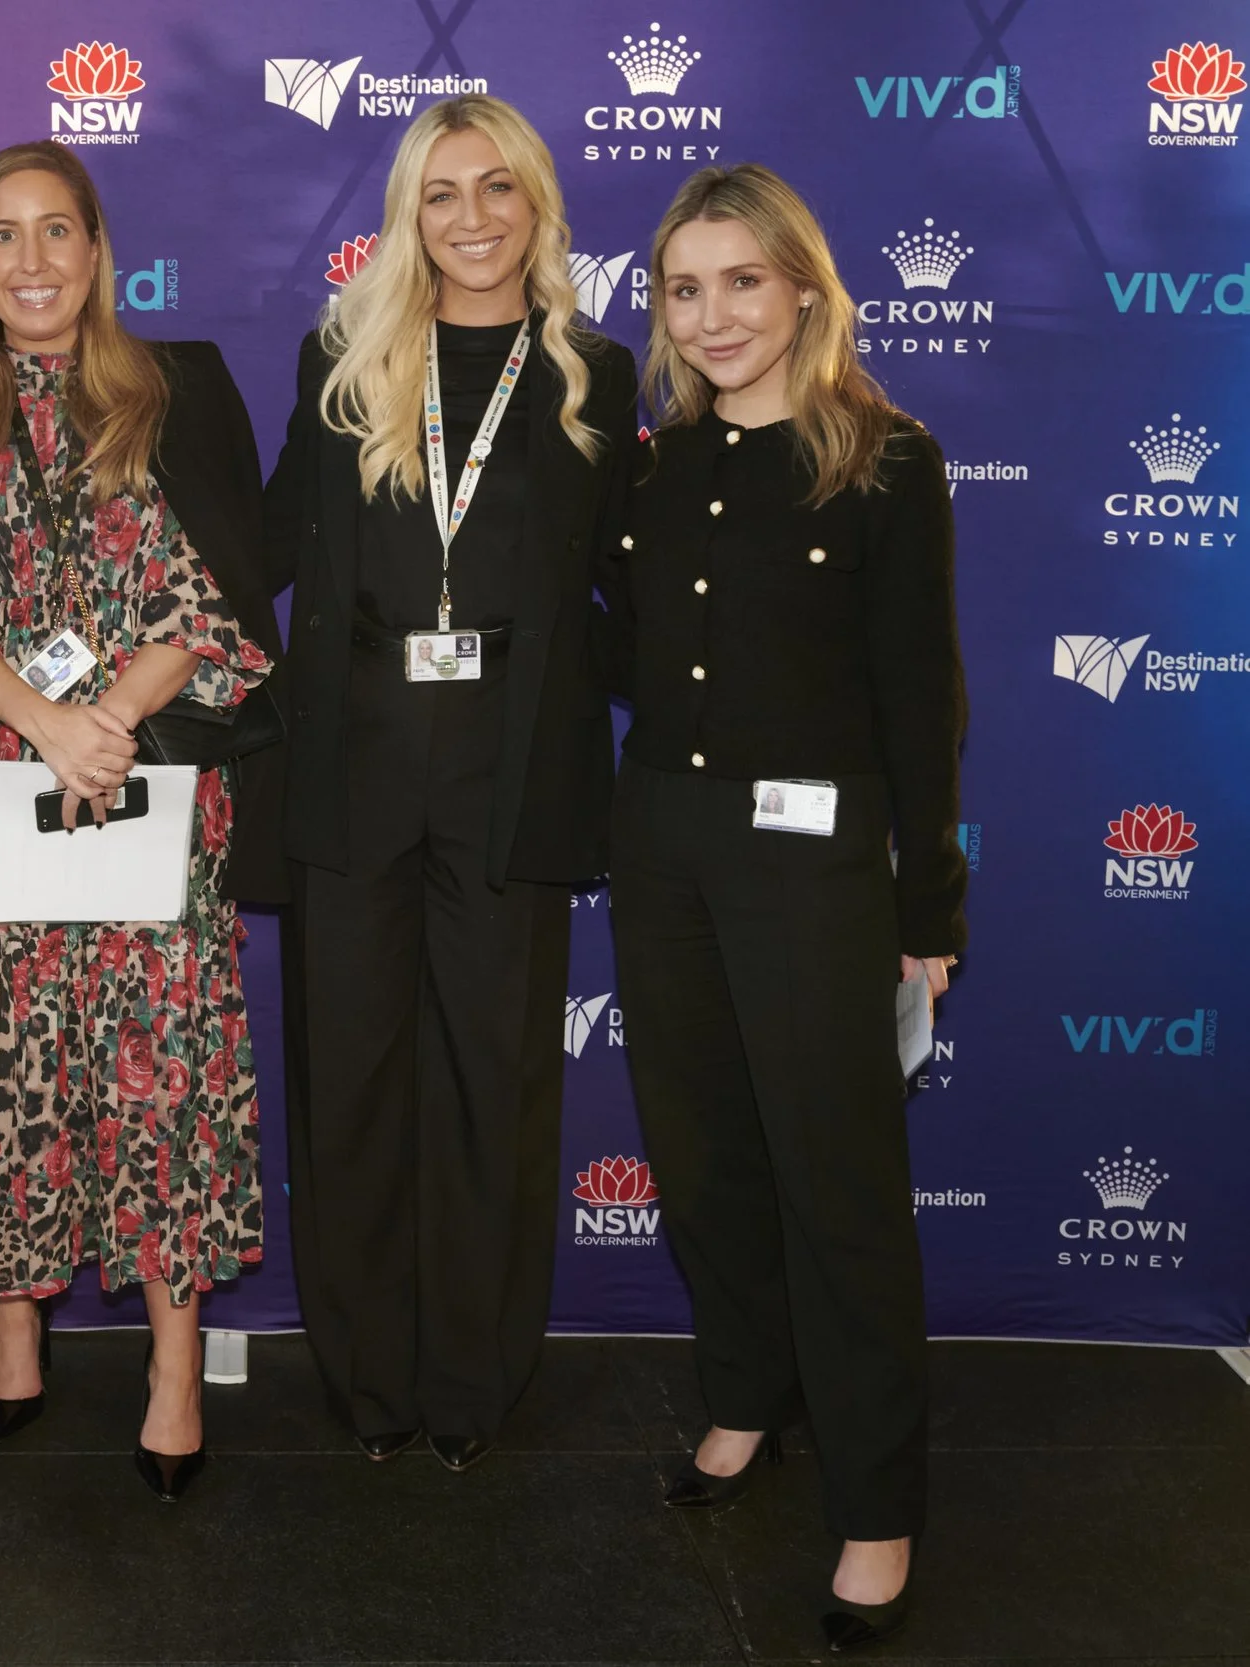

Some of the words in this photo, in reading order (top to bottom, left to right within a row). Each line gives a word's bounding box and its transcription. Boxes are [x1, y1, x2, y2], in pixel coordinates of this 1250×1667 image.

[360, 74, 487, 94] Destination
[1007, 66, 1020, 117] SYDNEY
[360, 96, 415, 116] NSW
[52, 102, 142, 132] NSW
[585, 107, 721, 130] CROWN
[1150, 103, 1242, 133] NSW
[51, 134, 139, 144] GOVERNMENT
[1149, 135, 1238, 146] GOVERNMENT
[585, 146, 719, 160] SYDNEY
[167, 259, 178, 309] SYDNEY
[859, 301, 993, 324] CROWN
[858, 339, 990, 353] SYDNEY
[945, 461, 1027, 480] tination
[1105, 494, 1238, 517] CROWN
[1104, 531, 1235, 546] SYDNEY
[1146, 672, 1200, 691] NSW
[970, 824, 981, 871] SYDNEY
[1106, 859, 1193, 887] NSW
[1104, 889, 1189, 899] GOVERNMENT
[1206, 1009, 1217, 1056] SYDNEY
[915, 1188, 985, 1206] ination
[576, 1209, 659, 1234] NSW
[1060, 1219, 1186, 1241] CROWN
[575, 1237, 657, 1245] GOVERNMENT
[1058, 1253, 1182, 1268] SYDNEY
